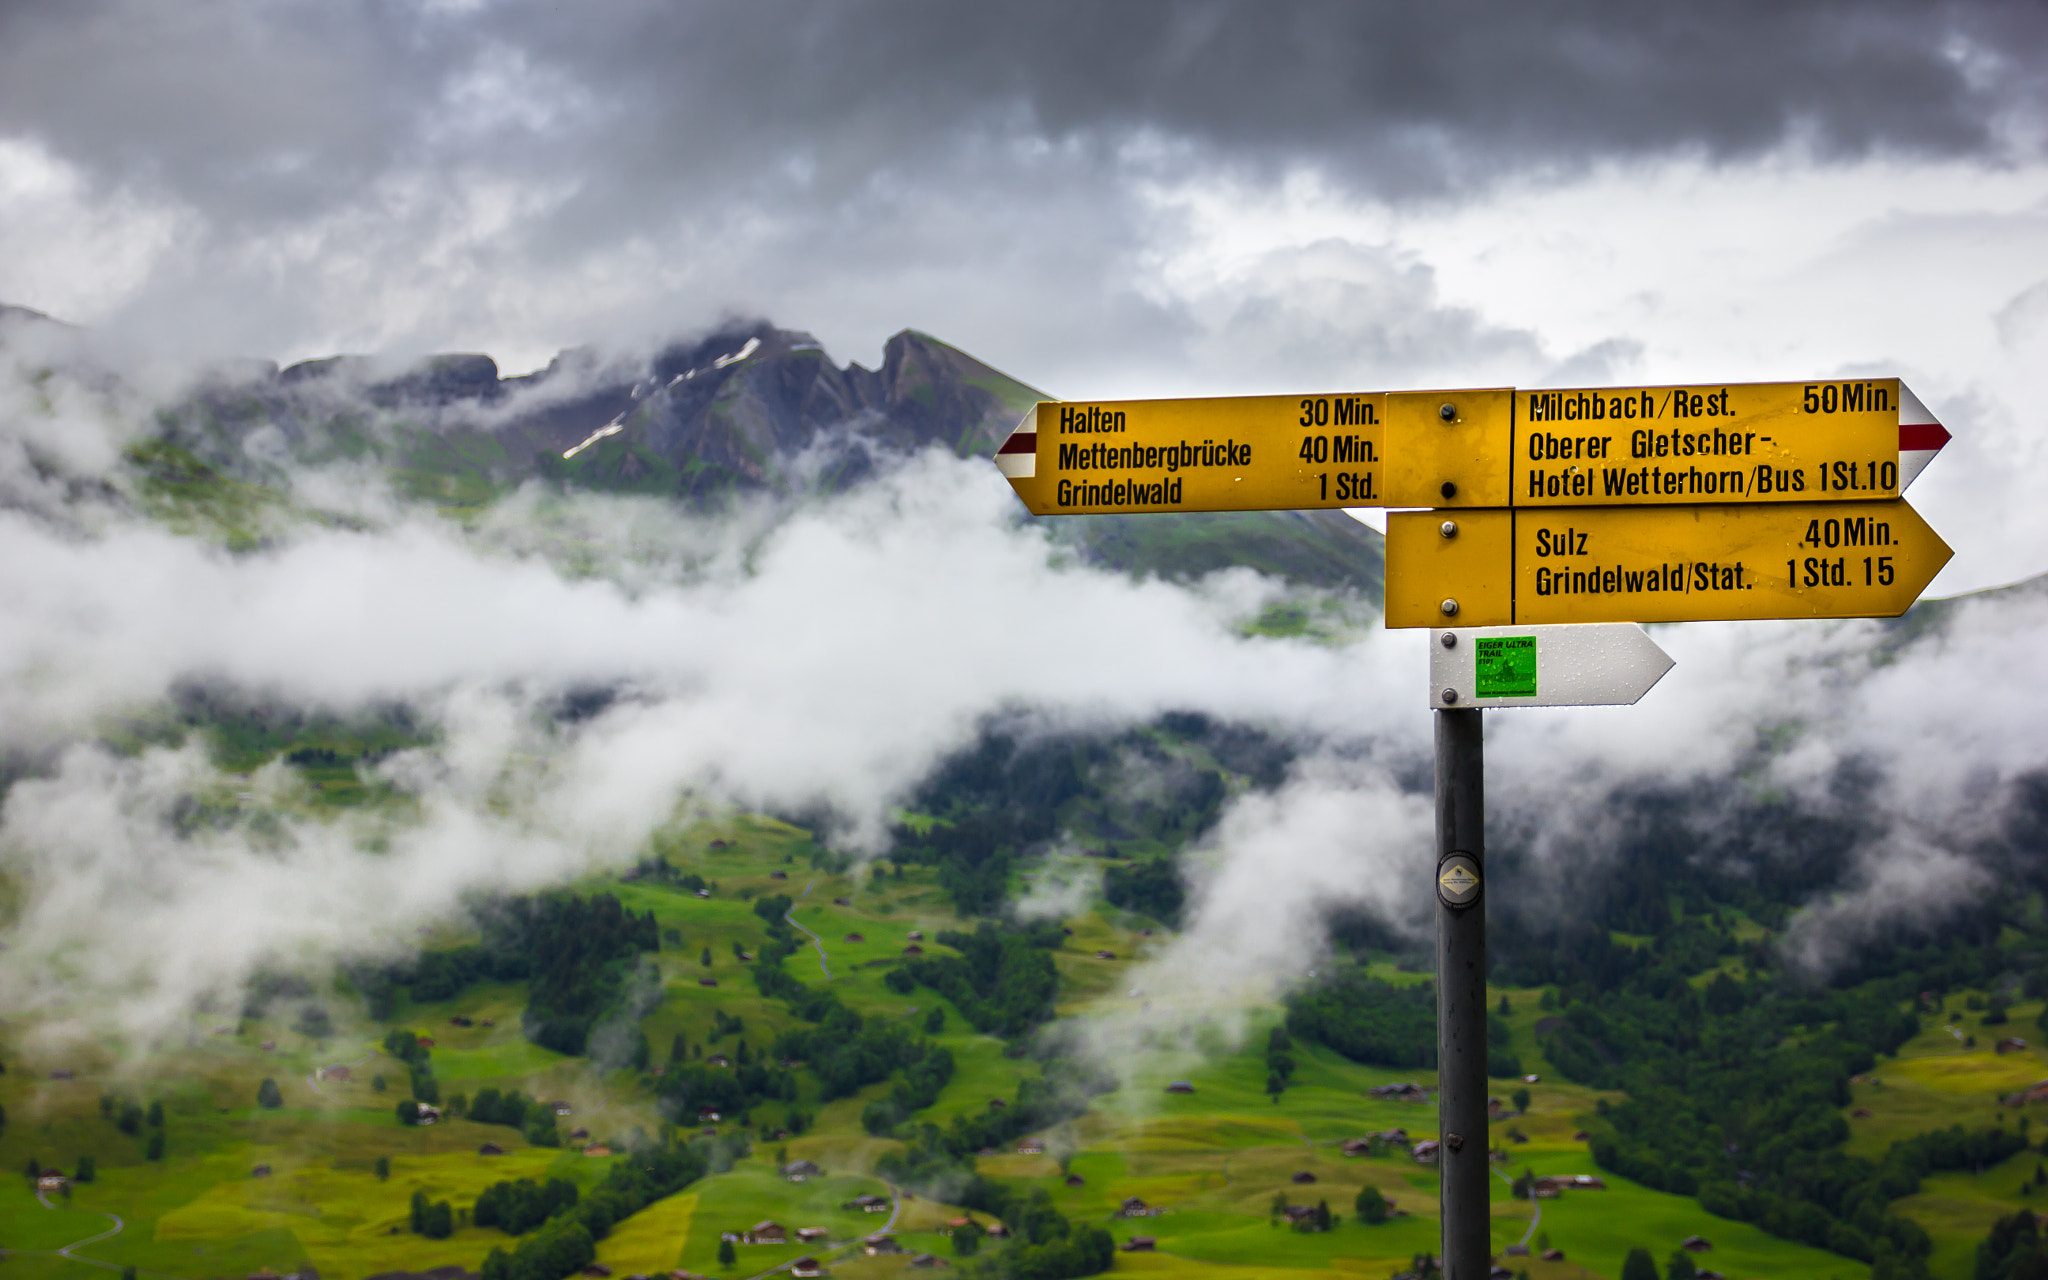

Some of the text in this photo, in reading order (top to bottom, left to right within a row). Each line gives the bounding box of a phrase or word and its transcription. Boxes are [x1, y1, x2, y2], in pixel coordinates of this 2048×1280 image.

[1060, 397, 1380, 434] Halten 30 Min.
[1529, 388, 1736, 422] Milchbach/Rest.
[1058, 434, 1379, 473] Mettenbergbrücke 40 Min.
[1529, 428, 1773, 461] Oberer Gletscher-
[1057, 472, 1378, 507] Grindelwald 1 Std.
[1528, 467, 1594, 498] Hotel
[1602, 464, 1805, 498] Wetterhorn/Bus
[1535, 527, 1588, 558] Sulz
[1536, 561, 1752, 596] Grindelwald/Stat.
[1863, 556, 1895, 587] 15
[1478, 640, 1533, 650] EIGER ULTRA
[1478, 649, 1503, 658] TRAIL
